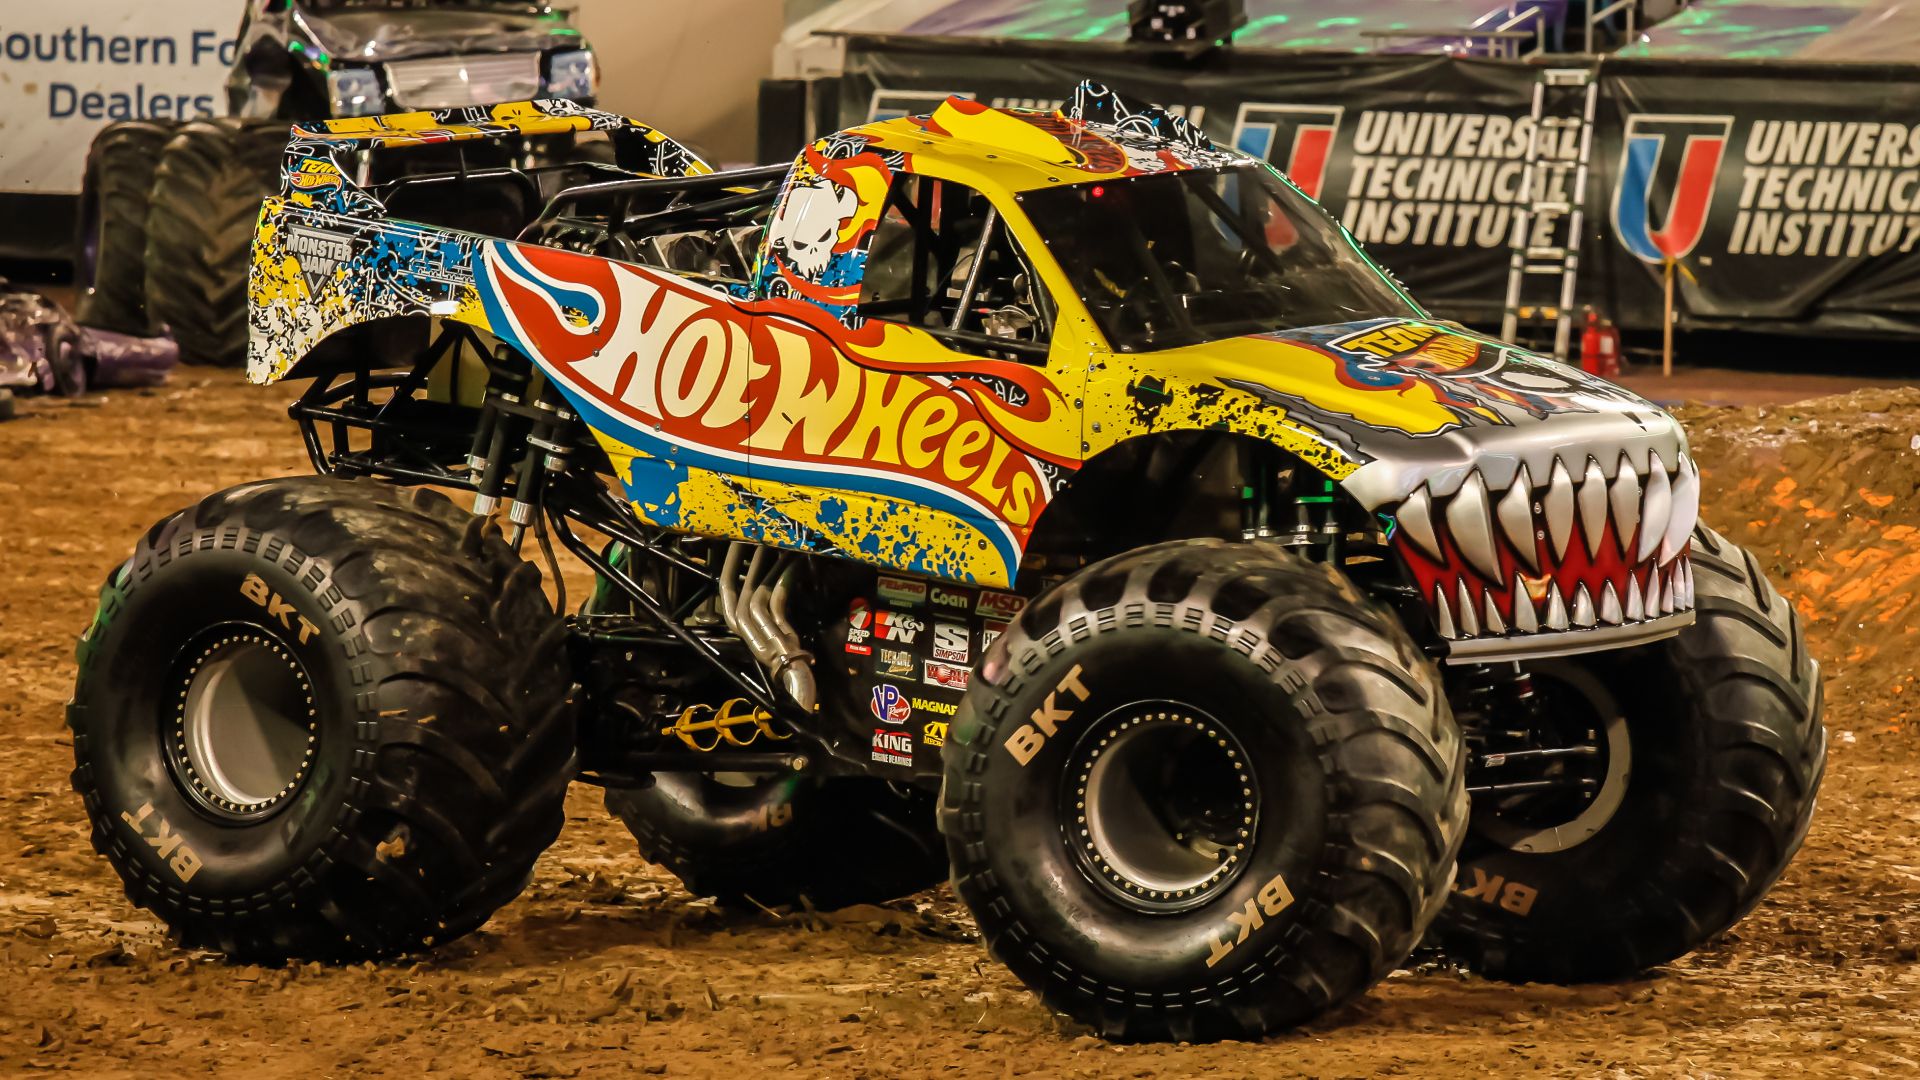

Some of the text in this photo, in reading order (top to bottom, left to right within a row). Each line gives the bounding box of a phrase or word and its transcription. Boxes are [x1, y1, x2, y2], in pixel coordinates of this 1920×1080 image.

[0, 25, 176, 65] outhern
[48, 82, 215, 120] Dealers
[1352, 110, 1582, 159] UNIVERSAL
[1346, 157, 1569, 204] TECHNICAL
[286, 233, 352, 263] MONSTER
[301, 254, 335, 276] JAM
[239, 572, 321, 646] BKT
[930, 587, 968, 608] Coan
[980, 591, 1025, 612] MSD
[848, 628, 870, 638] SPEED
[934, 648, 967, 662] SIMPSON
[1003, 663, 1091, 768] BKT
[872, 732, 912, 753] KING
[120, 802, 203, 884] BKT
[1450, 866, 1539, 917] BK
[1205, 873, 1296, 969] BKT
